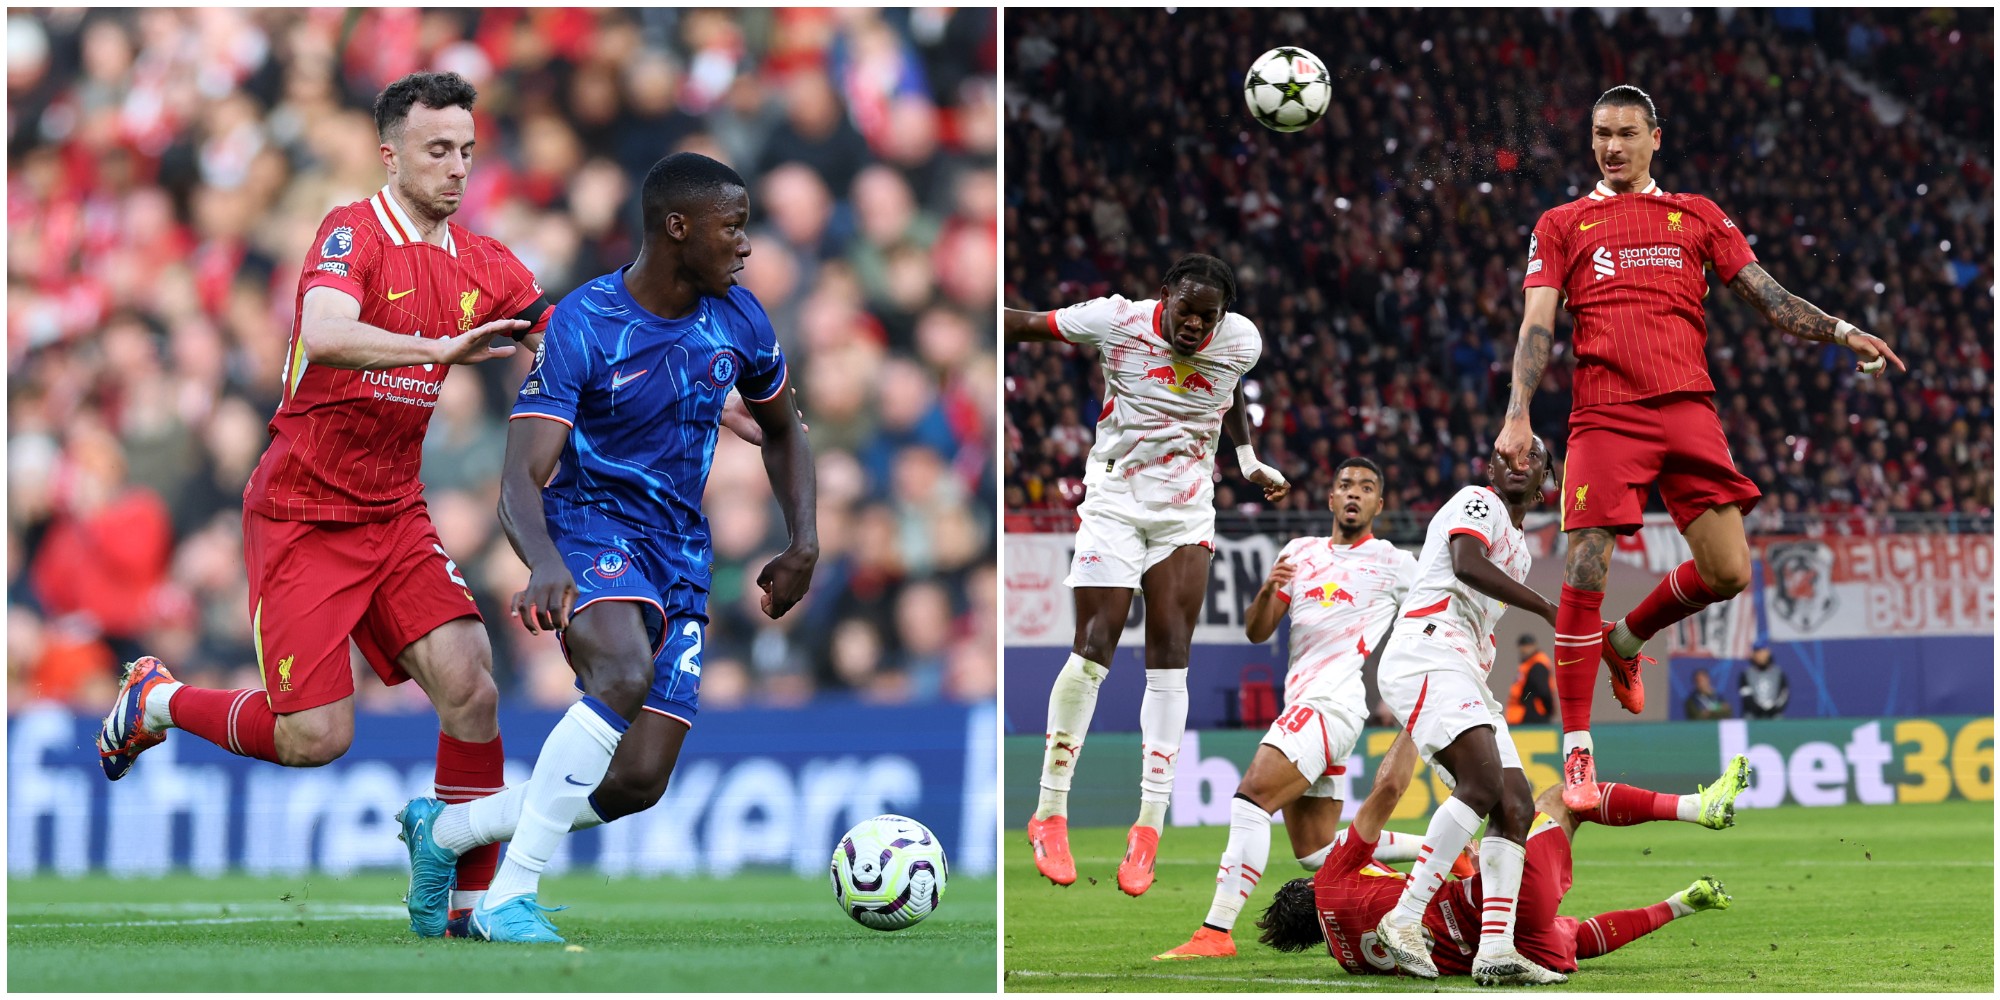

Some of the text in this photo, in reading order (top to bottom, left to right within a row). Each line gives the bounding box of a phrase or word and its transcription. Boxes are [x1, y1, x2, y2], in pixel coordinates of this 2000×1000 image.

[1618, 245, 1681, 260] standard
[1620, 256, 1683, 270] chartered
[457, 319, 474, 331] LFC
[374, 389, 385, 401] by
[385, 392, 416, 406] Standard
[679, 620, 702, 678] 2
[279, 683, 294, 692] LFC
[1151, 766, 1166, 775] RBL
